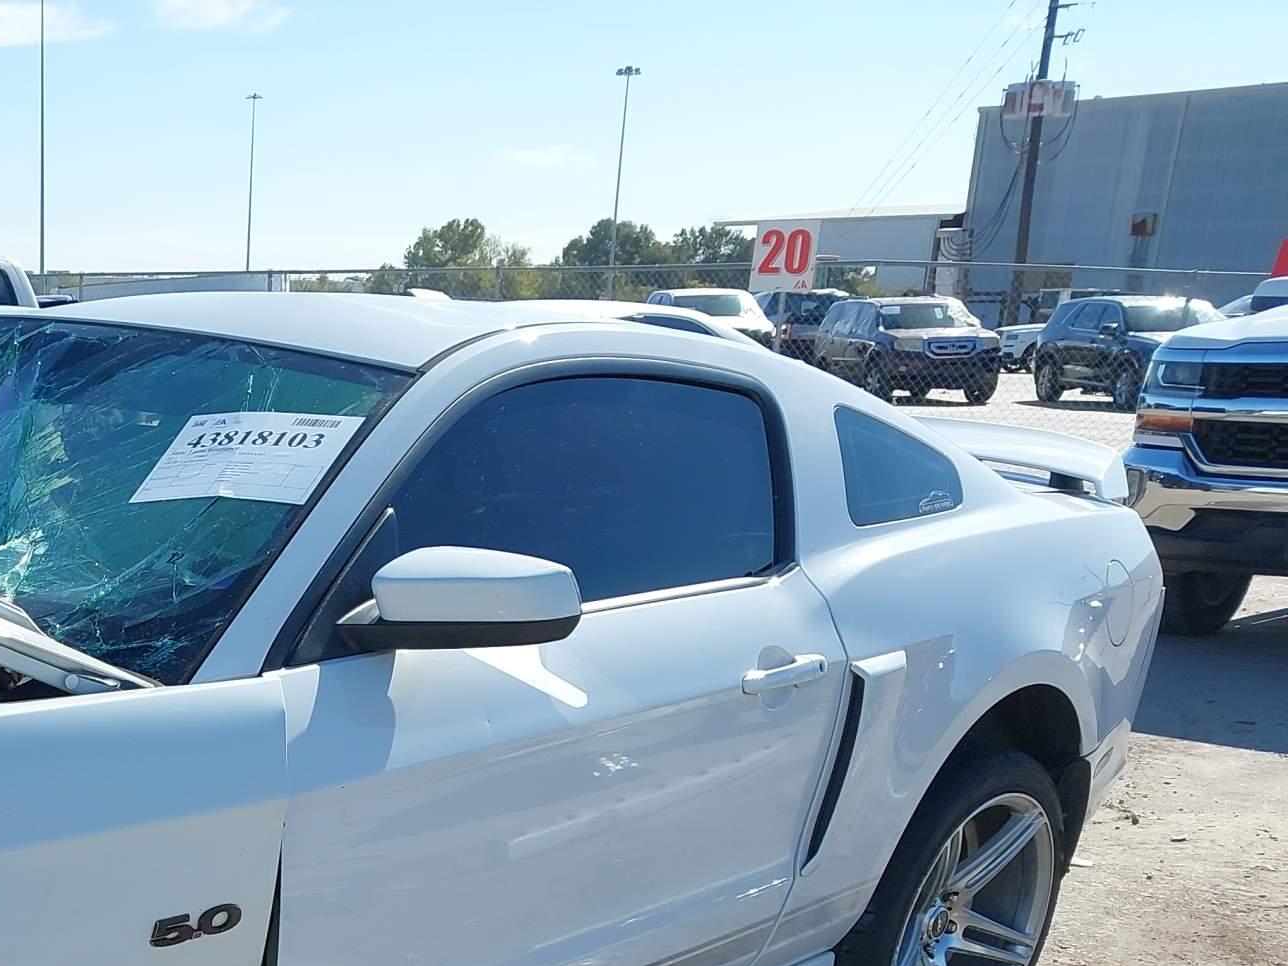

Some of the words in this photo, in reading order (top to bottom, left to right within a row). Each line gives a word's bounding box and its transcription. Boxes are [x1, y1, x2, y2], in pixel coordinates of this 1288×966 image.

[758, 229, 812, 275] 20
[186, 430, 326, 449] 43818103
[149, 903, 243, 948] 5.0
